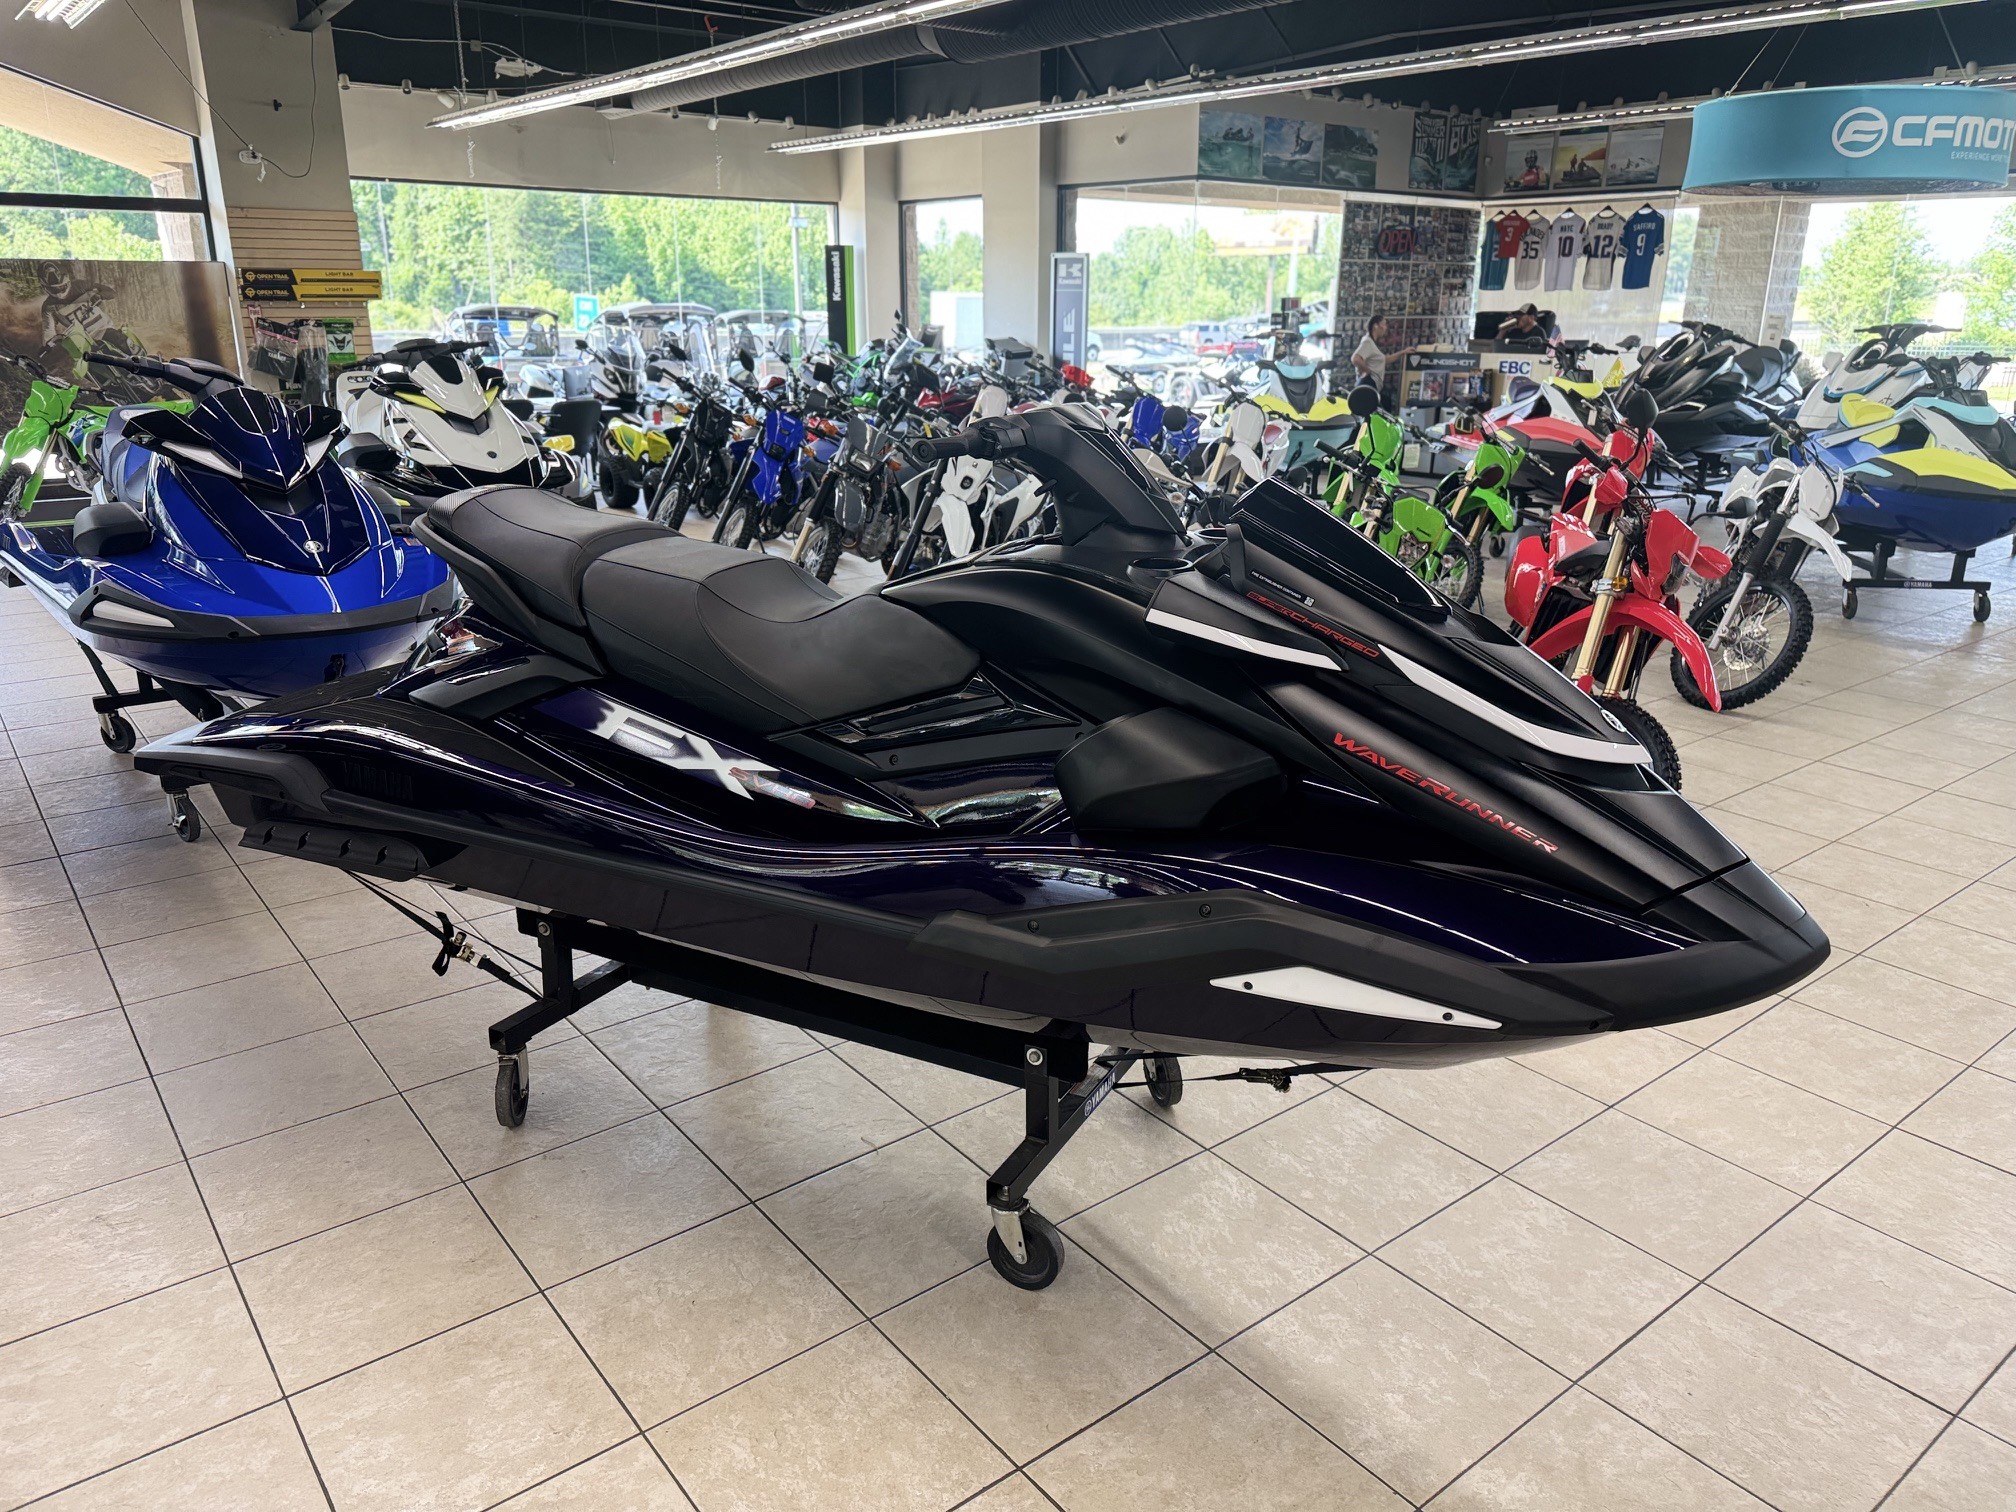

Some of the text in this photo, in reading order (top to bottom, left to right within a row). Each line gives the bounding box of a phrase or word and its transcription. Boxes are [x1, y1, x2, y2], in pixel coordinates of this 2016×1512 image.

[1415, 118, 1445, 138] SUMMER
[1892, 115, 2015, 150] CFMOT
[1951, 151, 1990, 161] EXPERIENCE
[1378, 230, 1416, 253] OPEN
[1505, 227, 1514, 241] 3
[1637, 233, 1646, 256] 9
[1521, 241, 1540, 259] 35
[1558, 236, 1575, 258] 10
[1591, 235, 1613, 258] 12
[831, 251, 841, 301] Kawasaki
[1420, 359, 1477, 367] SLINGSHOT
[1499, 361, 1530, 374] EBC
[1246, 592, 1380, 658] SUPERCHARGED
[1334, 732, 1558, 854] WAVERUNNER
[1091, 1072, 1116, 1109] YAMAHA
